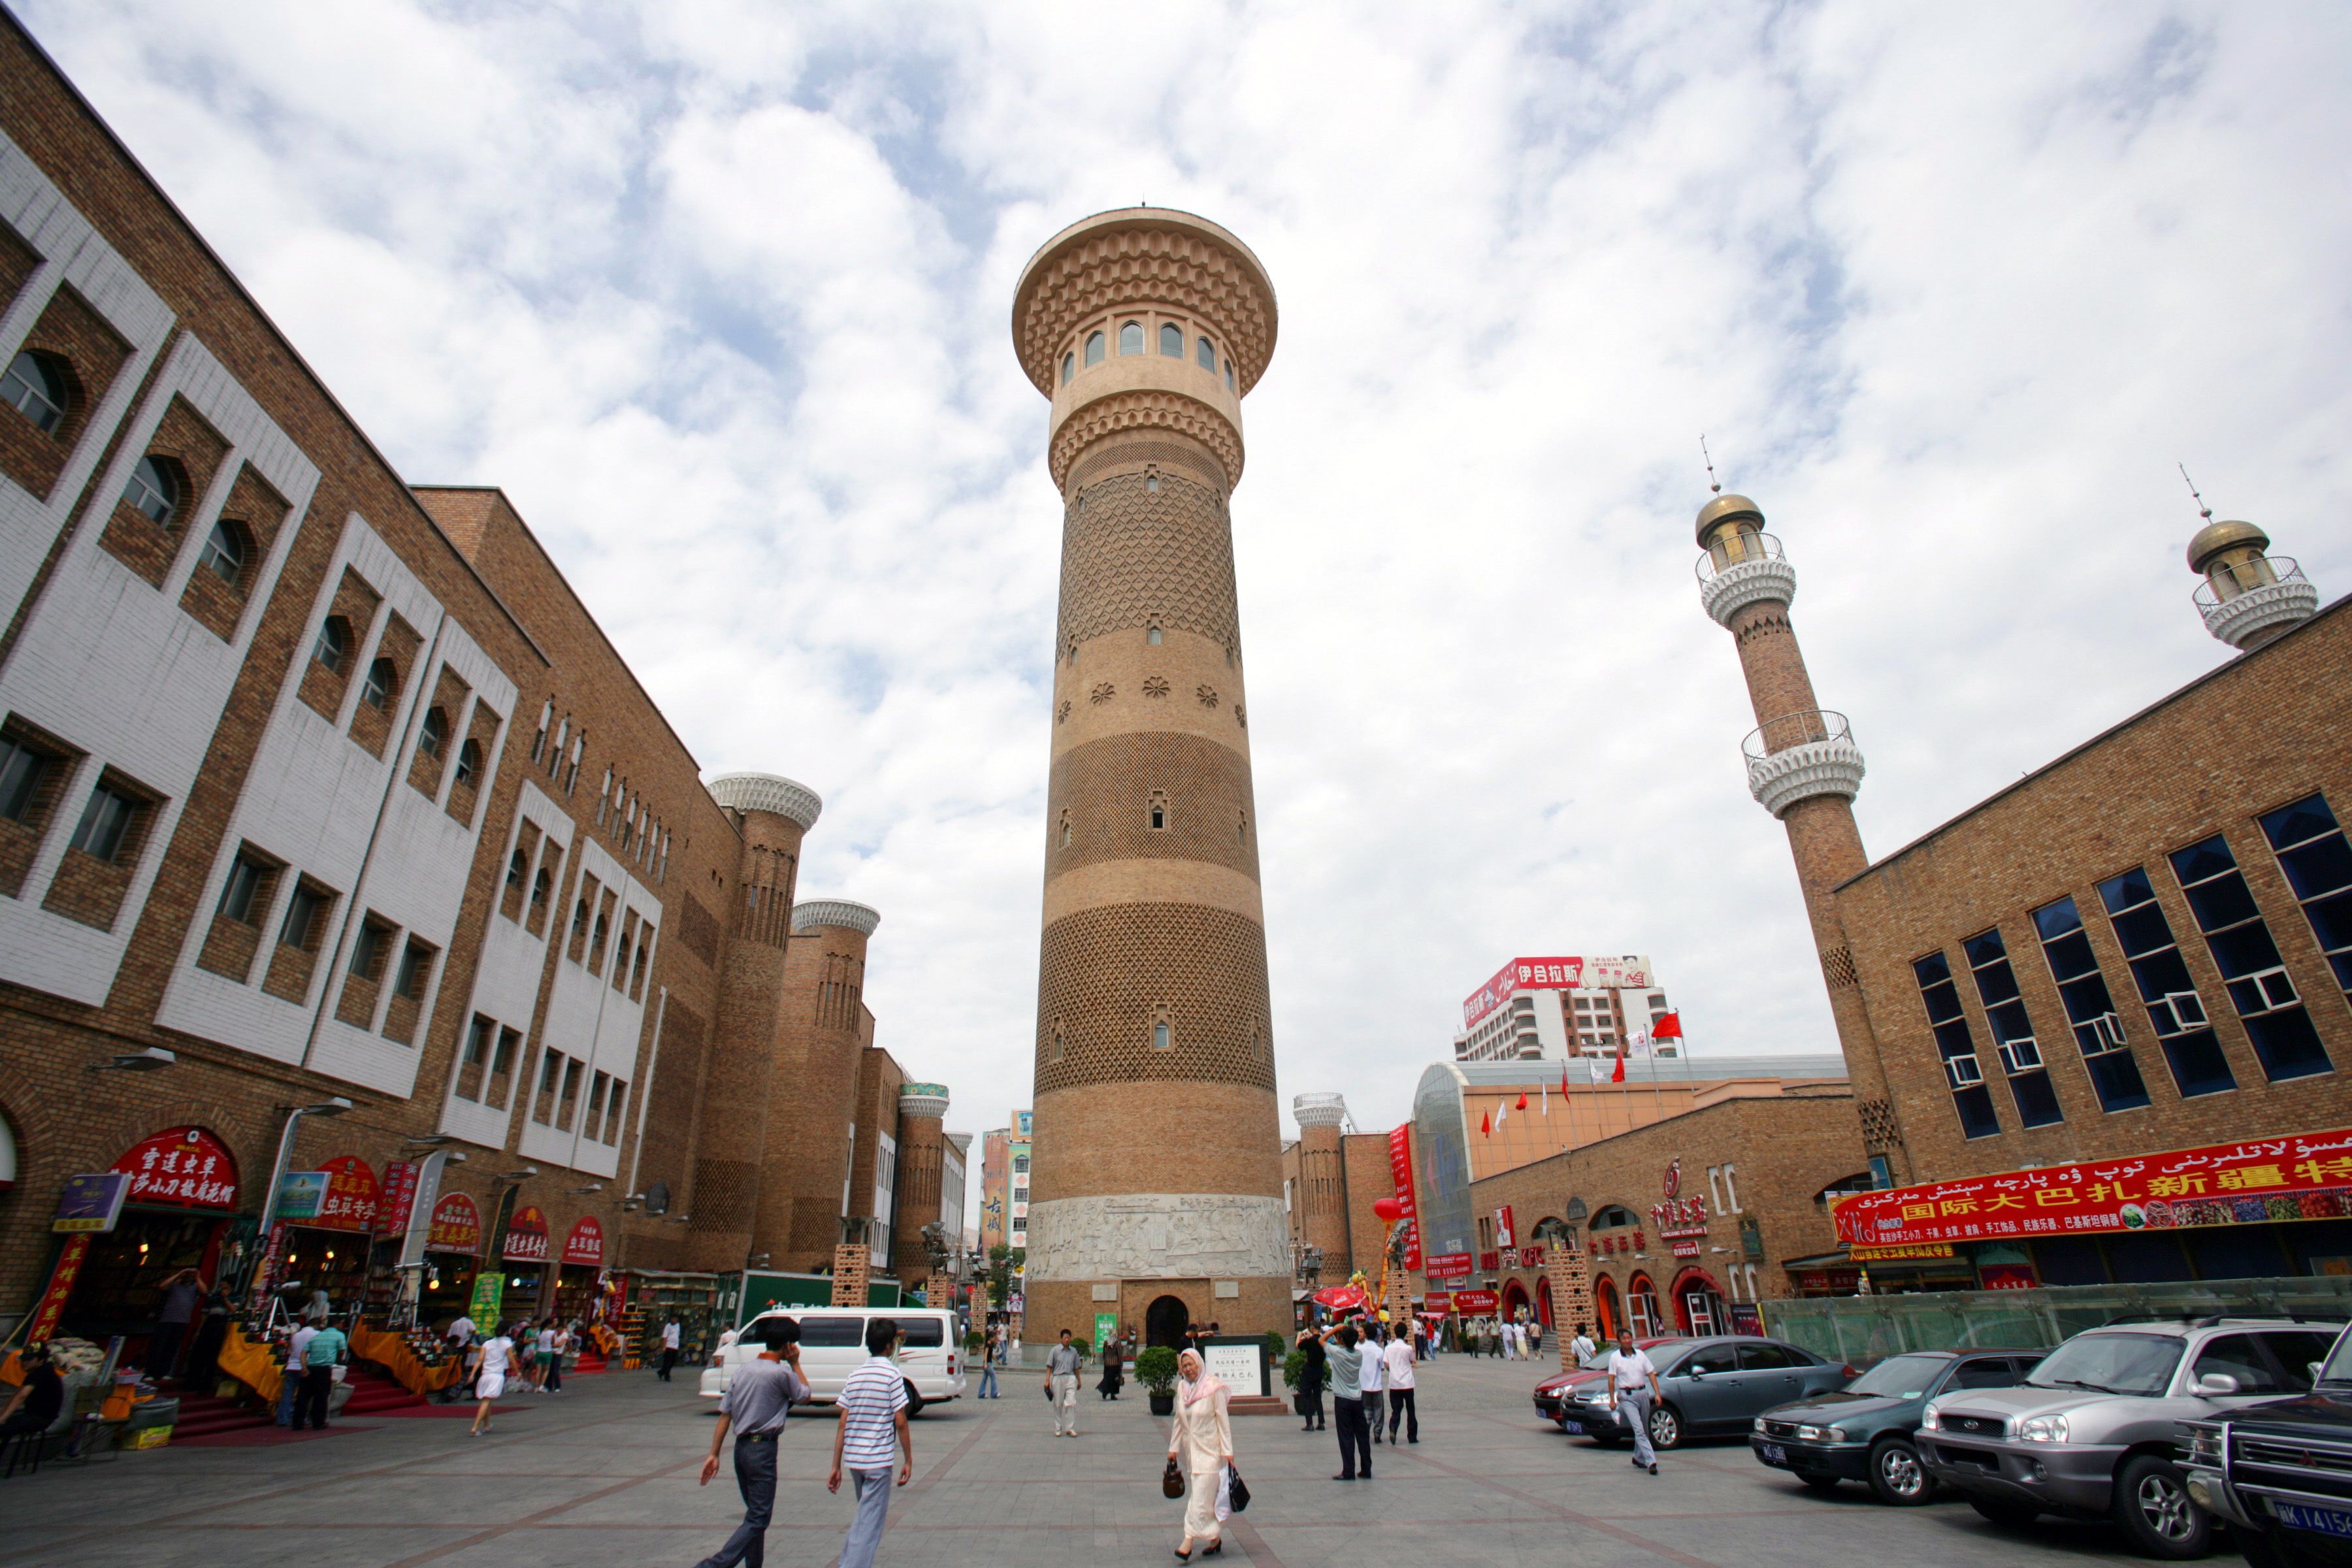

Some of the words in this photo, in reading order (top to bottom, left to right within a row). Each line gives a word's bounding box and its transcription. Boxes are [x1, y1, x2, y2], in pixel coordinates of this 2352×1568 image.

[1518, 964, 1578, 983] 伊合拉斯
[1464, 992, 1485, 1023] 伊合拉斯
[320, 1195, 377, 1220] 虫草专卖
[1521, 1246, 1545, 1266] KFC
